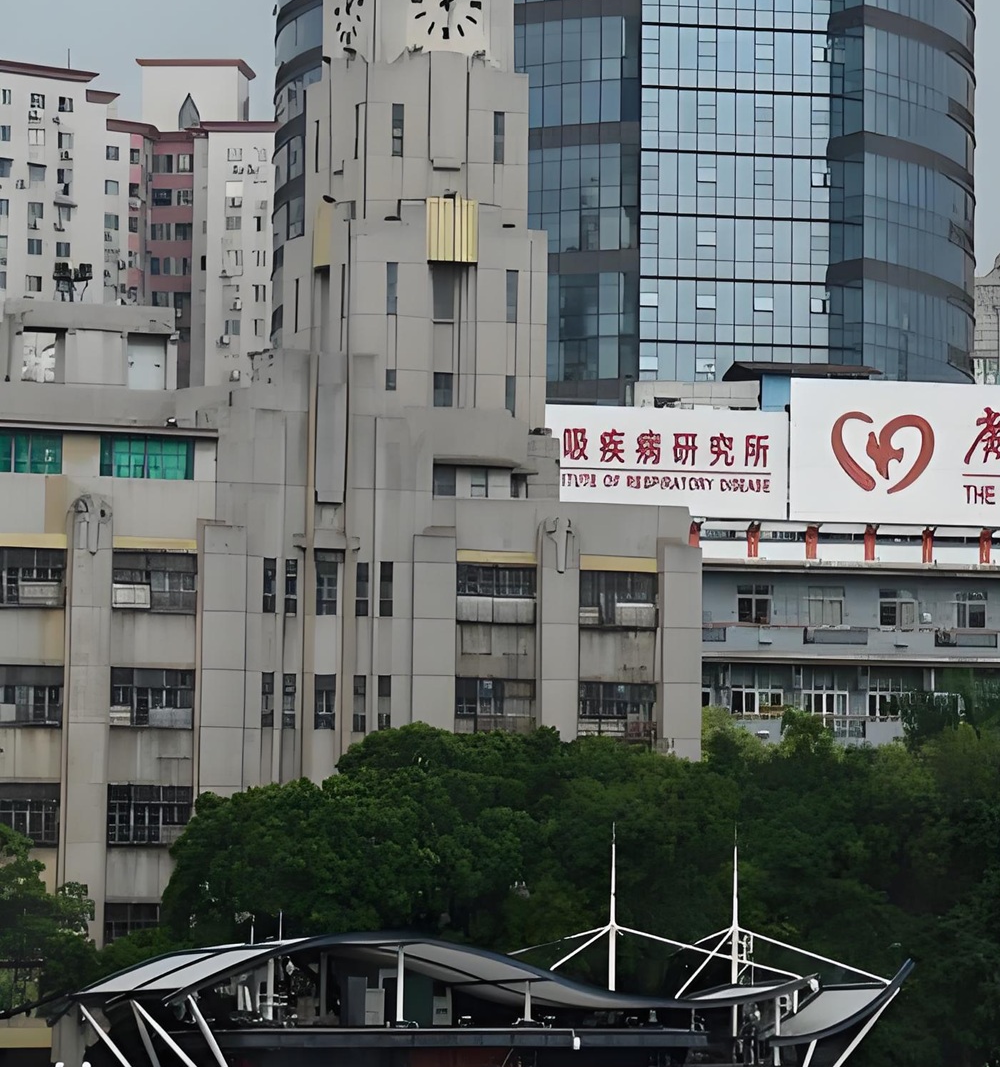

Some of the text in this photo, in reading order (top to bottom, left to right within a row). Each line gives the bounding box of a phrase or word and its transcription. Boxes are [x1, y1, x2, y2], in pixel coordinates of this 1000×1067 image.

[563, 428, 770, 468] 吸疾病研究所
[963, 485, 996, 505] THE
